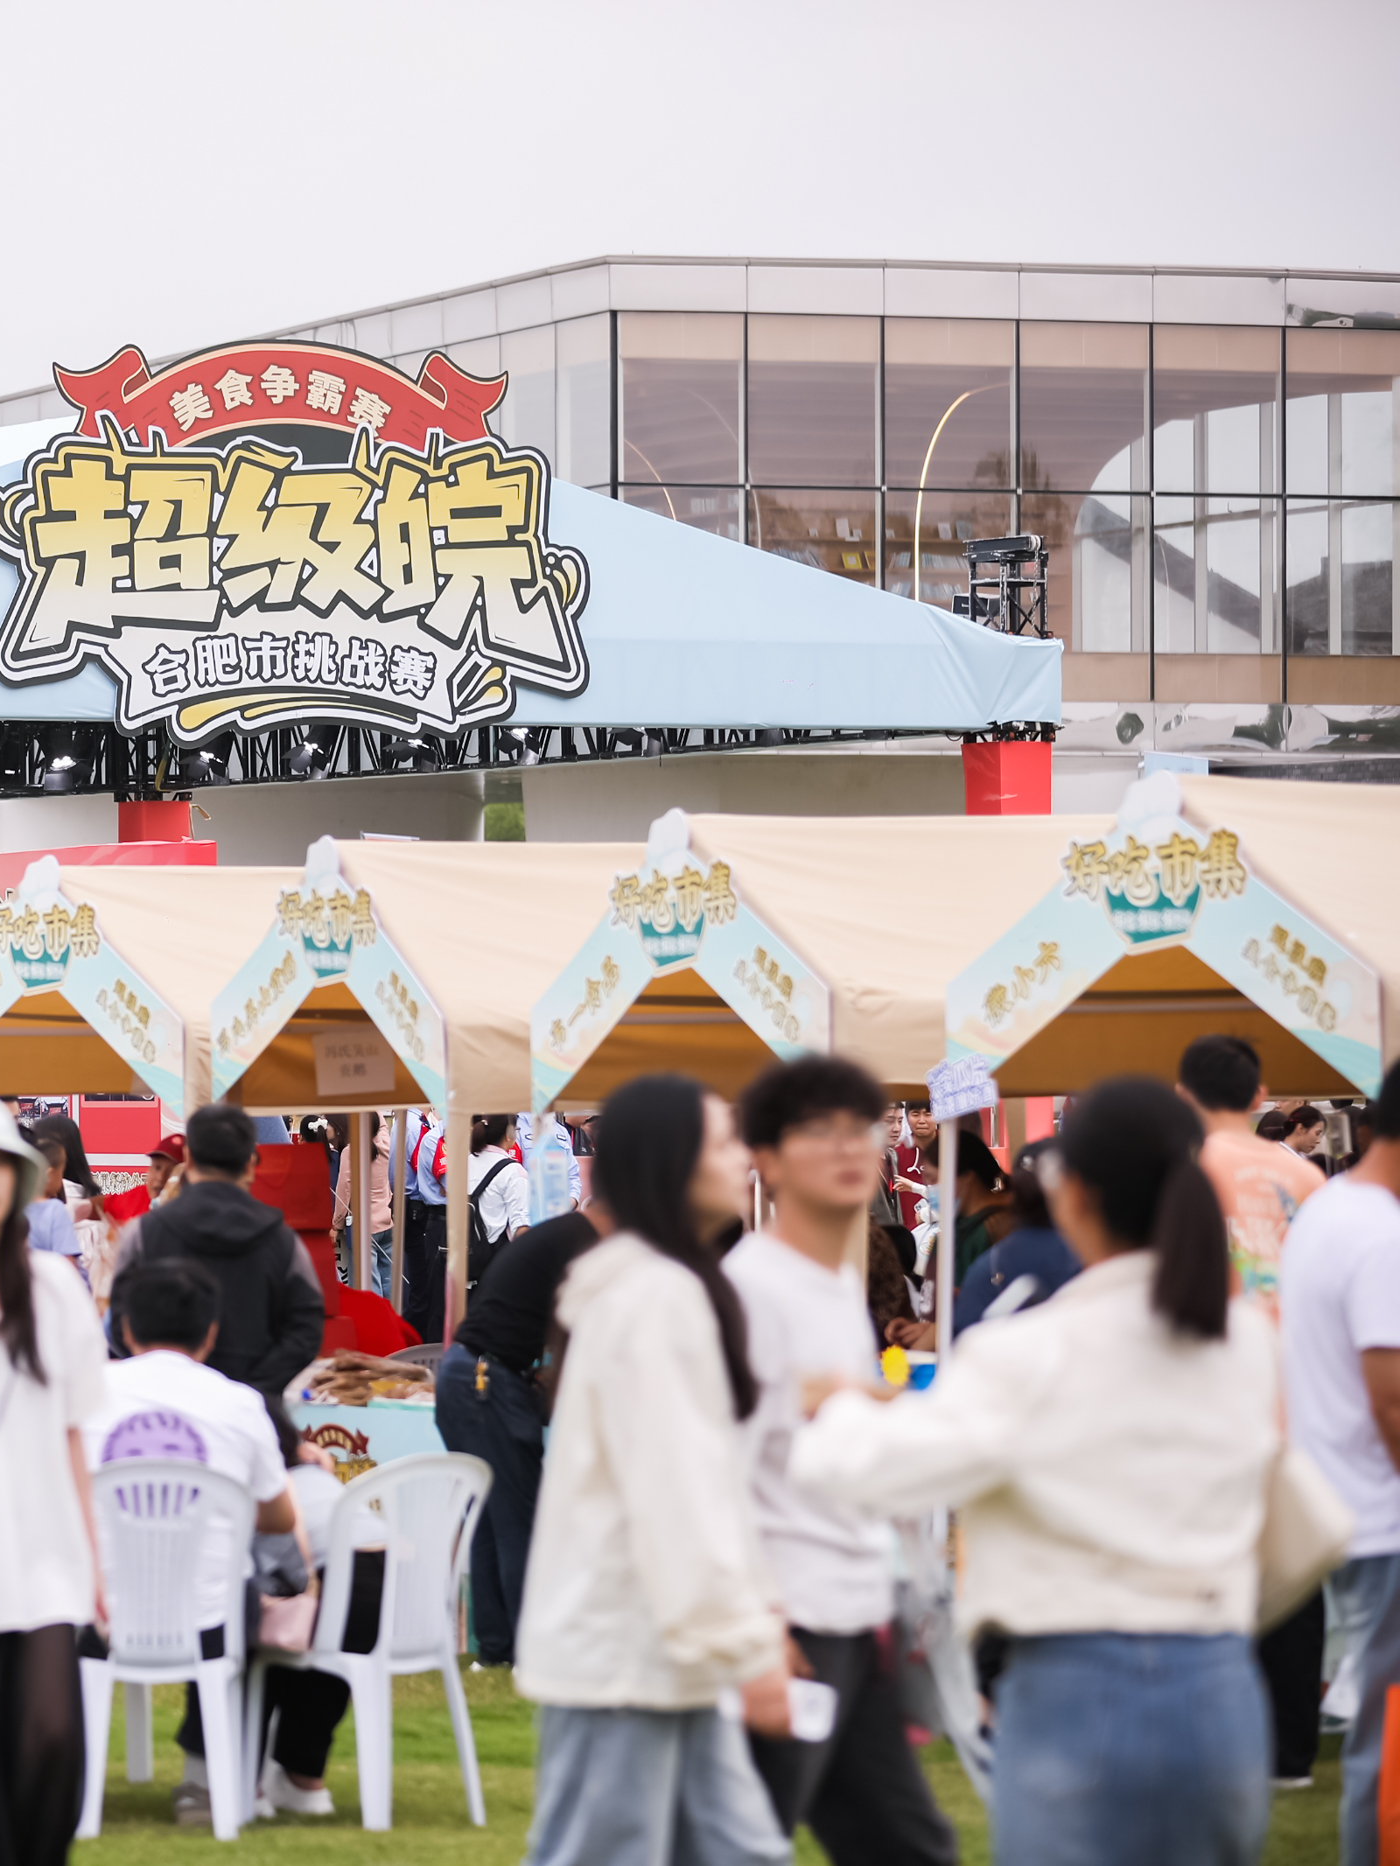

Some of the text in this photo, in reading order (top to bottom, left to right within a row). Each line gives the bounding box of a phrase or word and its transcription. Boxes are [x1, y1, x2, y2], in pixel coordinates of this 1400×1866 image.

[168, 364, 392, 438] 美食争霸赛
[18, 448, 573, 664] 超级皖
[146, 631, 438, 700] 合肥市挑战赛
[610, 859, 739, 934] 好吃市集
[1061, 827, 1248, 907] 好吃市集
[277, 887, 377, 950] 好吃市集
